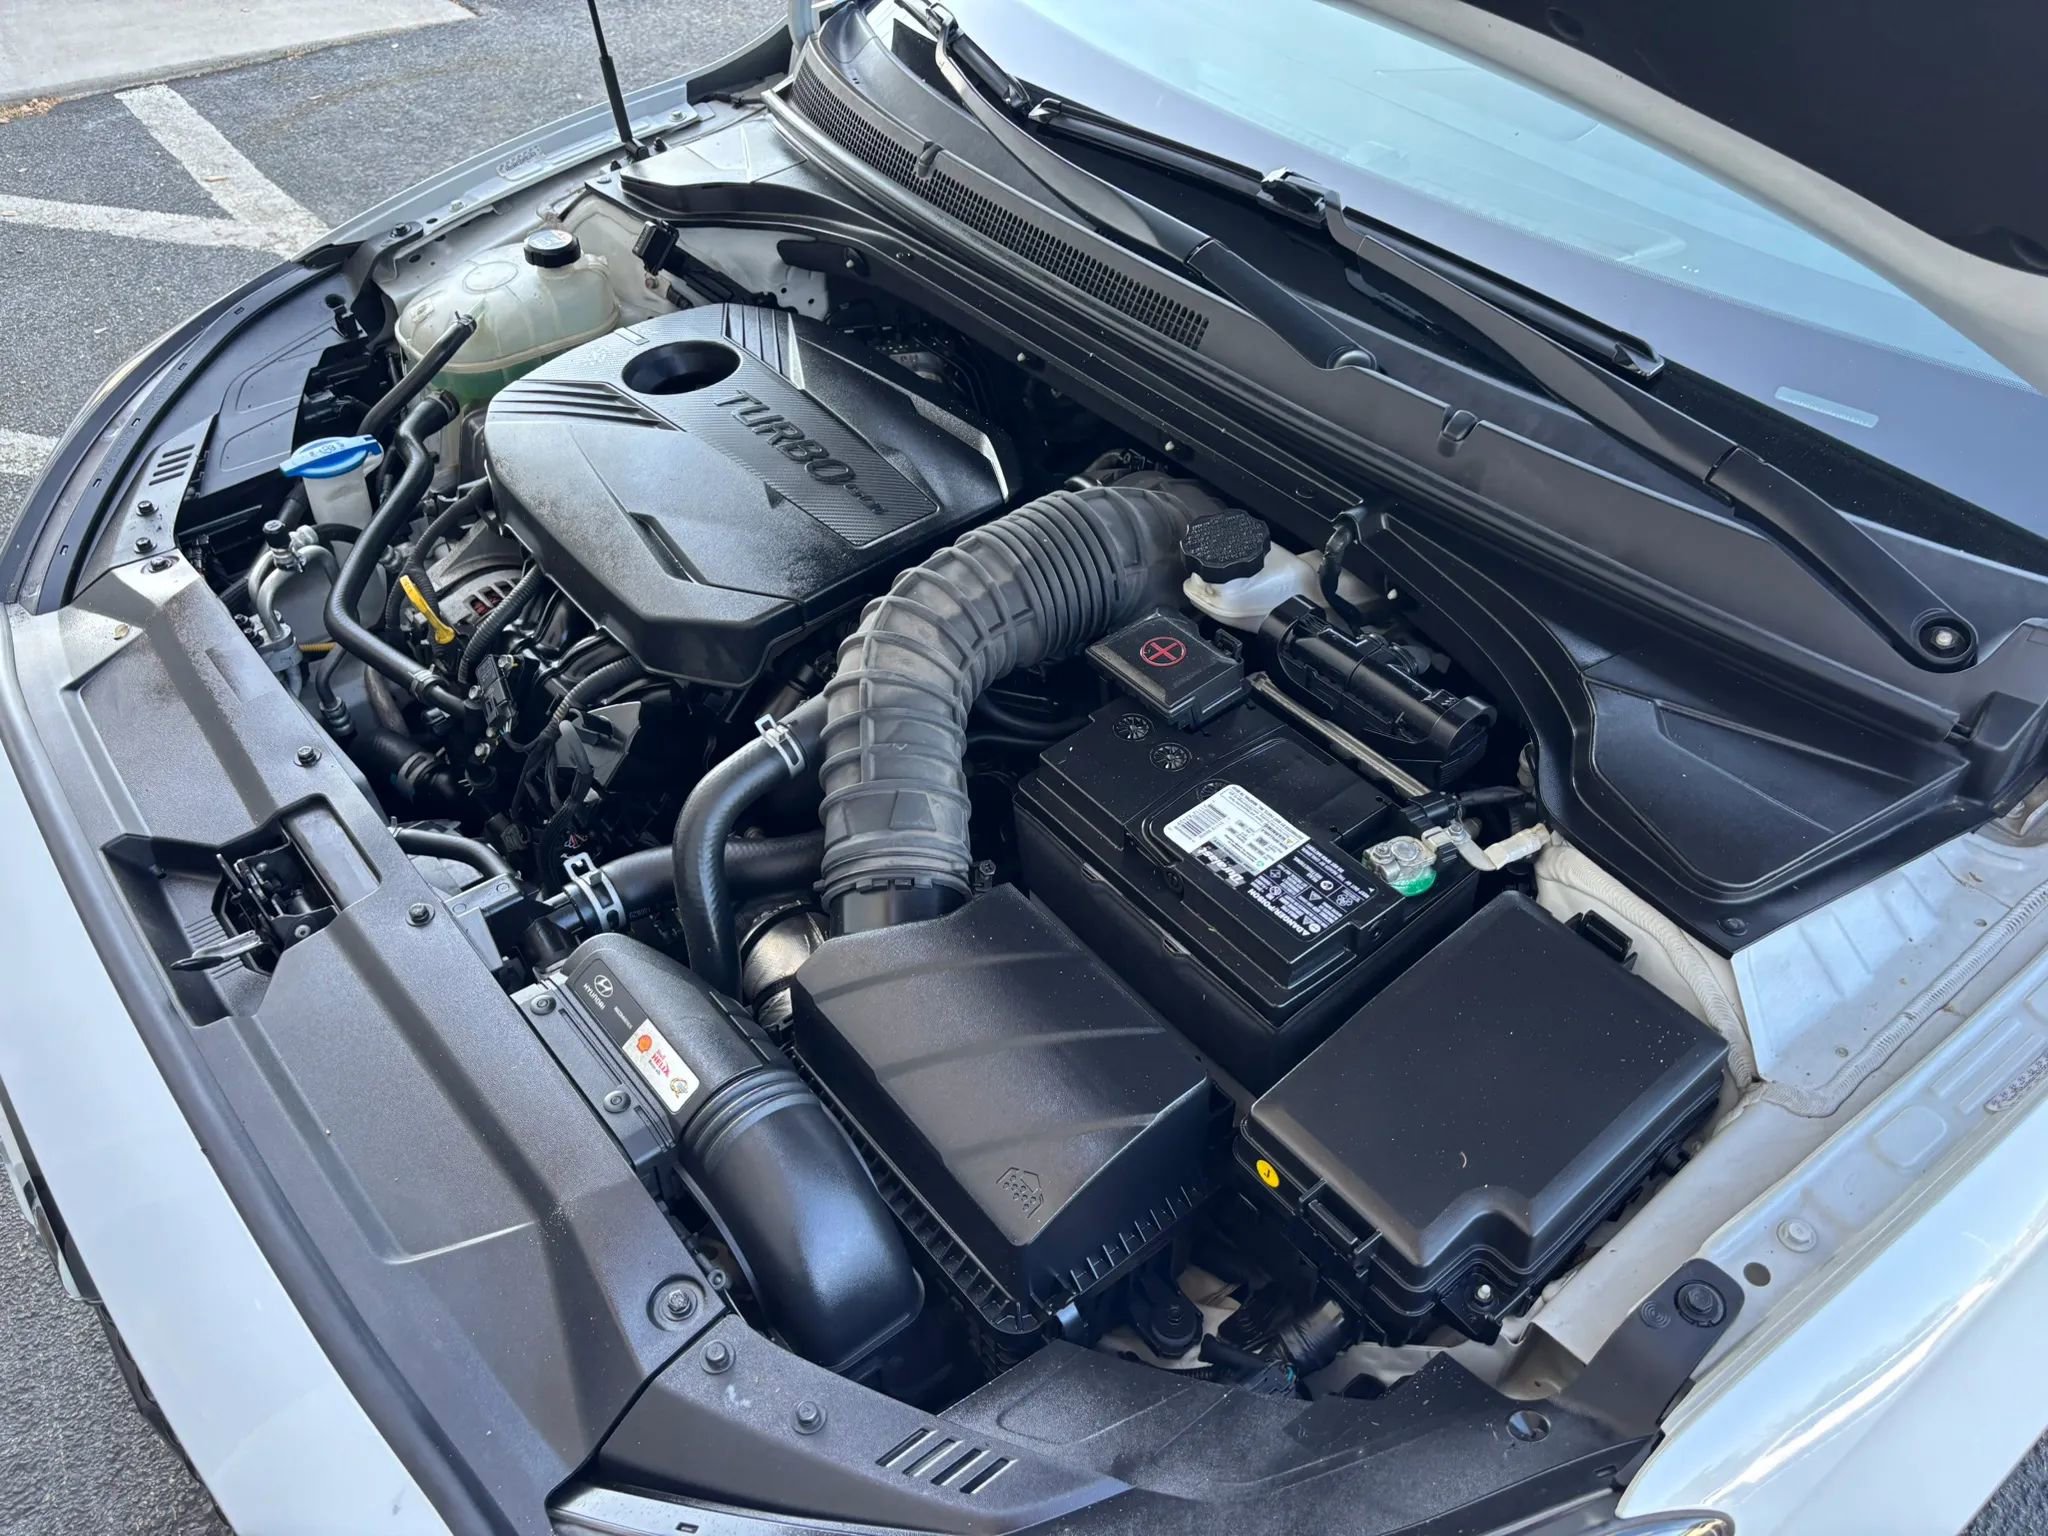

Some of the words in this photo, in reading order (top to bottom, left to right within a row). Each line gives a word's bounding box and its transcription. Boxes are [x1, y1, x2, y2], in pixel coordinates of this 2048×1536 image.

[714, 389, 856, 484] TURBO
[1196, 846, 1244, 883] Duralast
[1245, 887, 1305, 933] DANGER/POISON
[583, 983, 606, 1010] HYUNDAI
